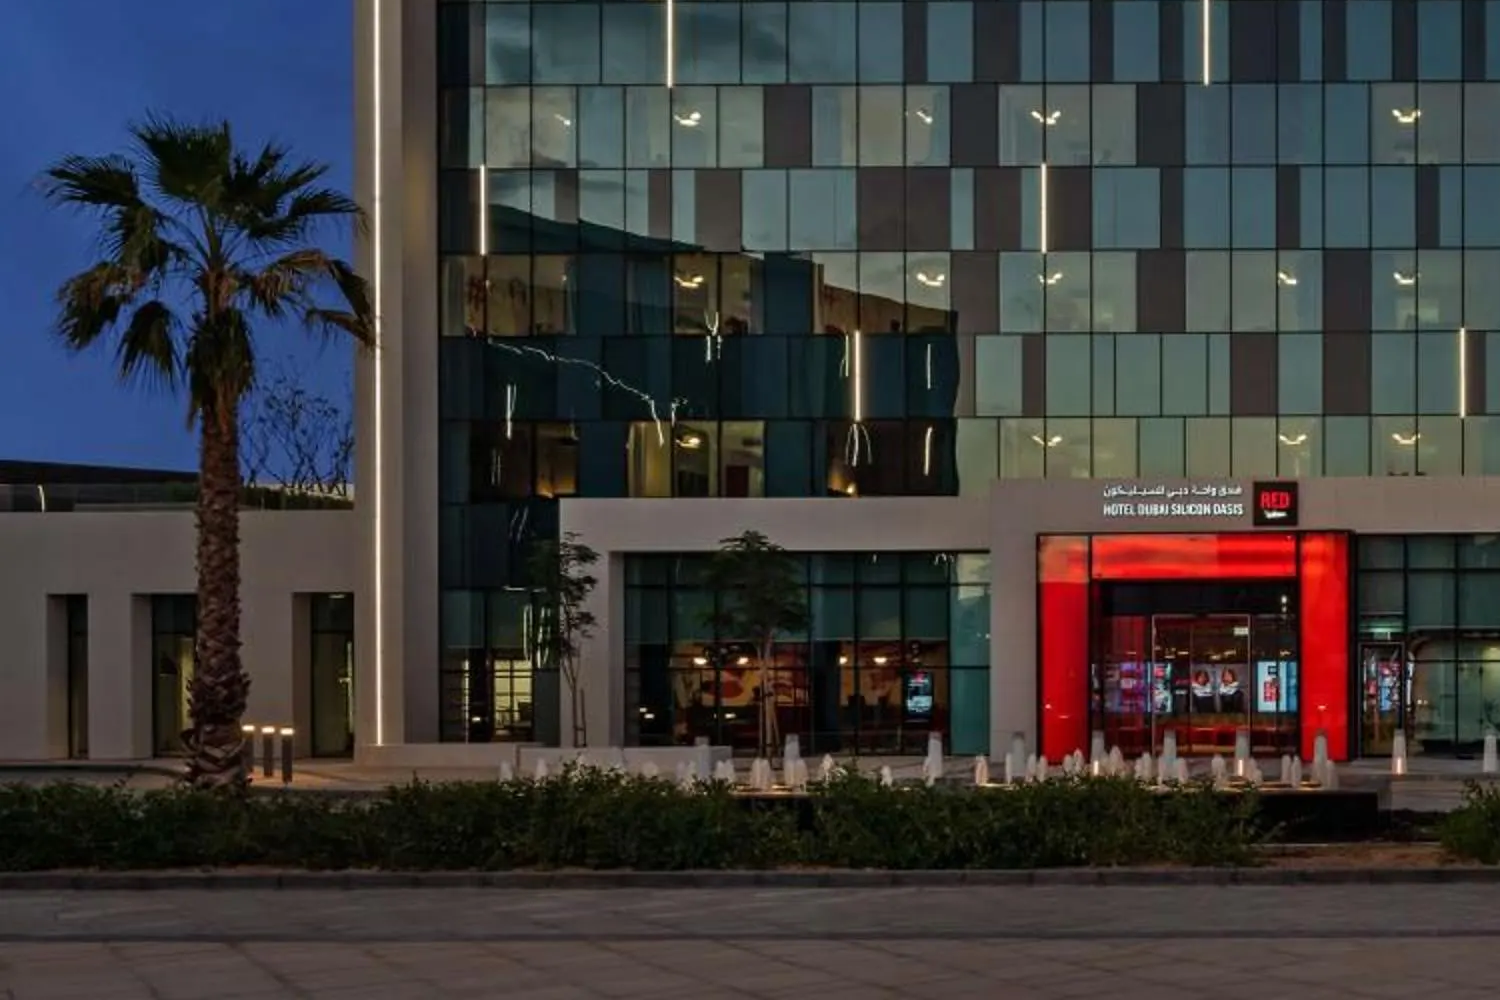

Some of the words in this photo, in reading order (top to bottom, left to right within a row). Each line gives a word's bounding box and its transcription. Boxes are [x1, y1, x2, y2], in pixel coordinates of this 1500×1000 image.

[1261, 491, 1289, 510] RED
[1103, 503, 1136, 516] HOTEL
[1137, 503, 1169, 516] DUBAI
[1171, 503, 1211, 516] SILICON
[1213, 503, 1244, 516] OASIS
